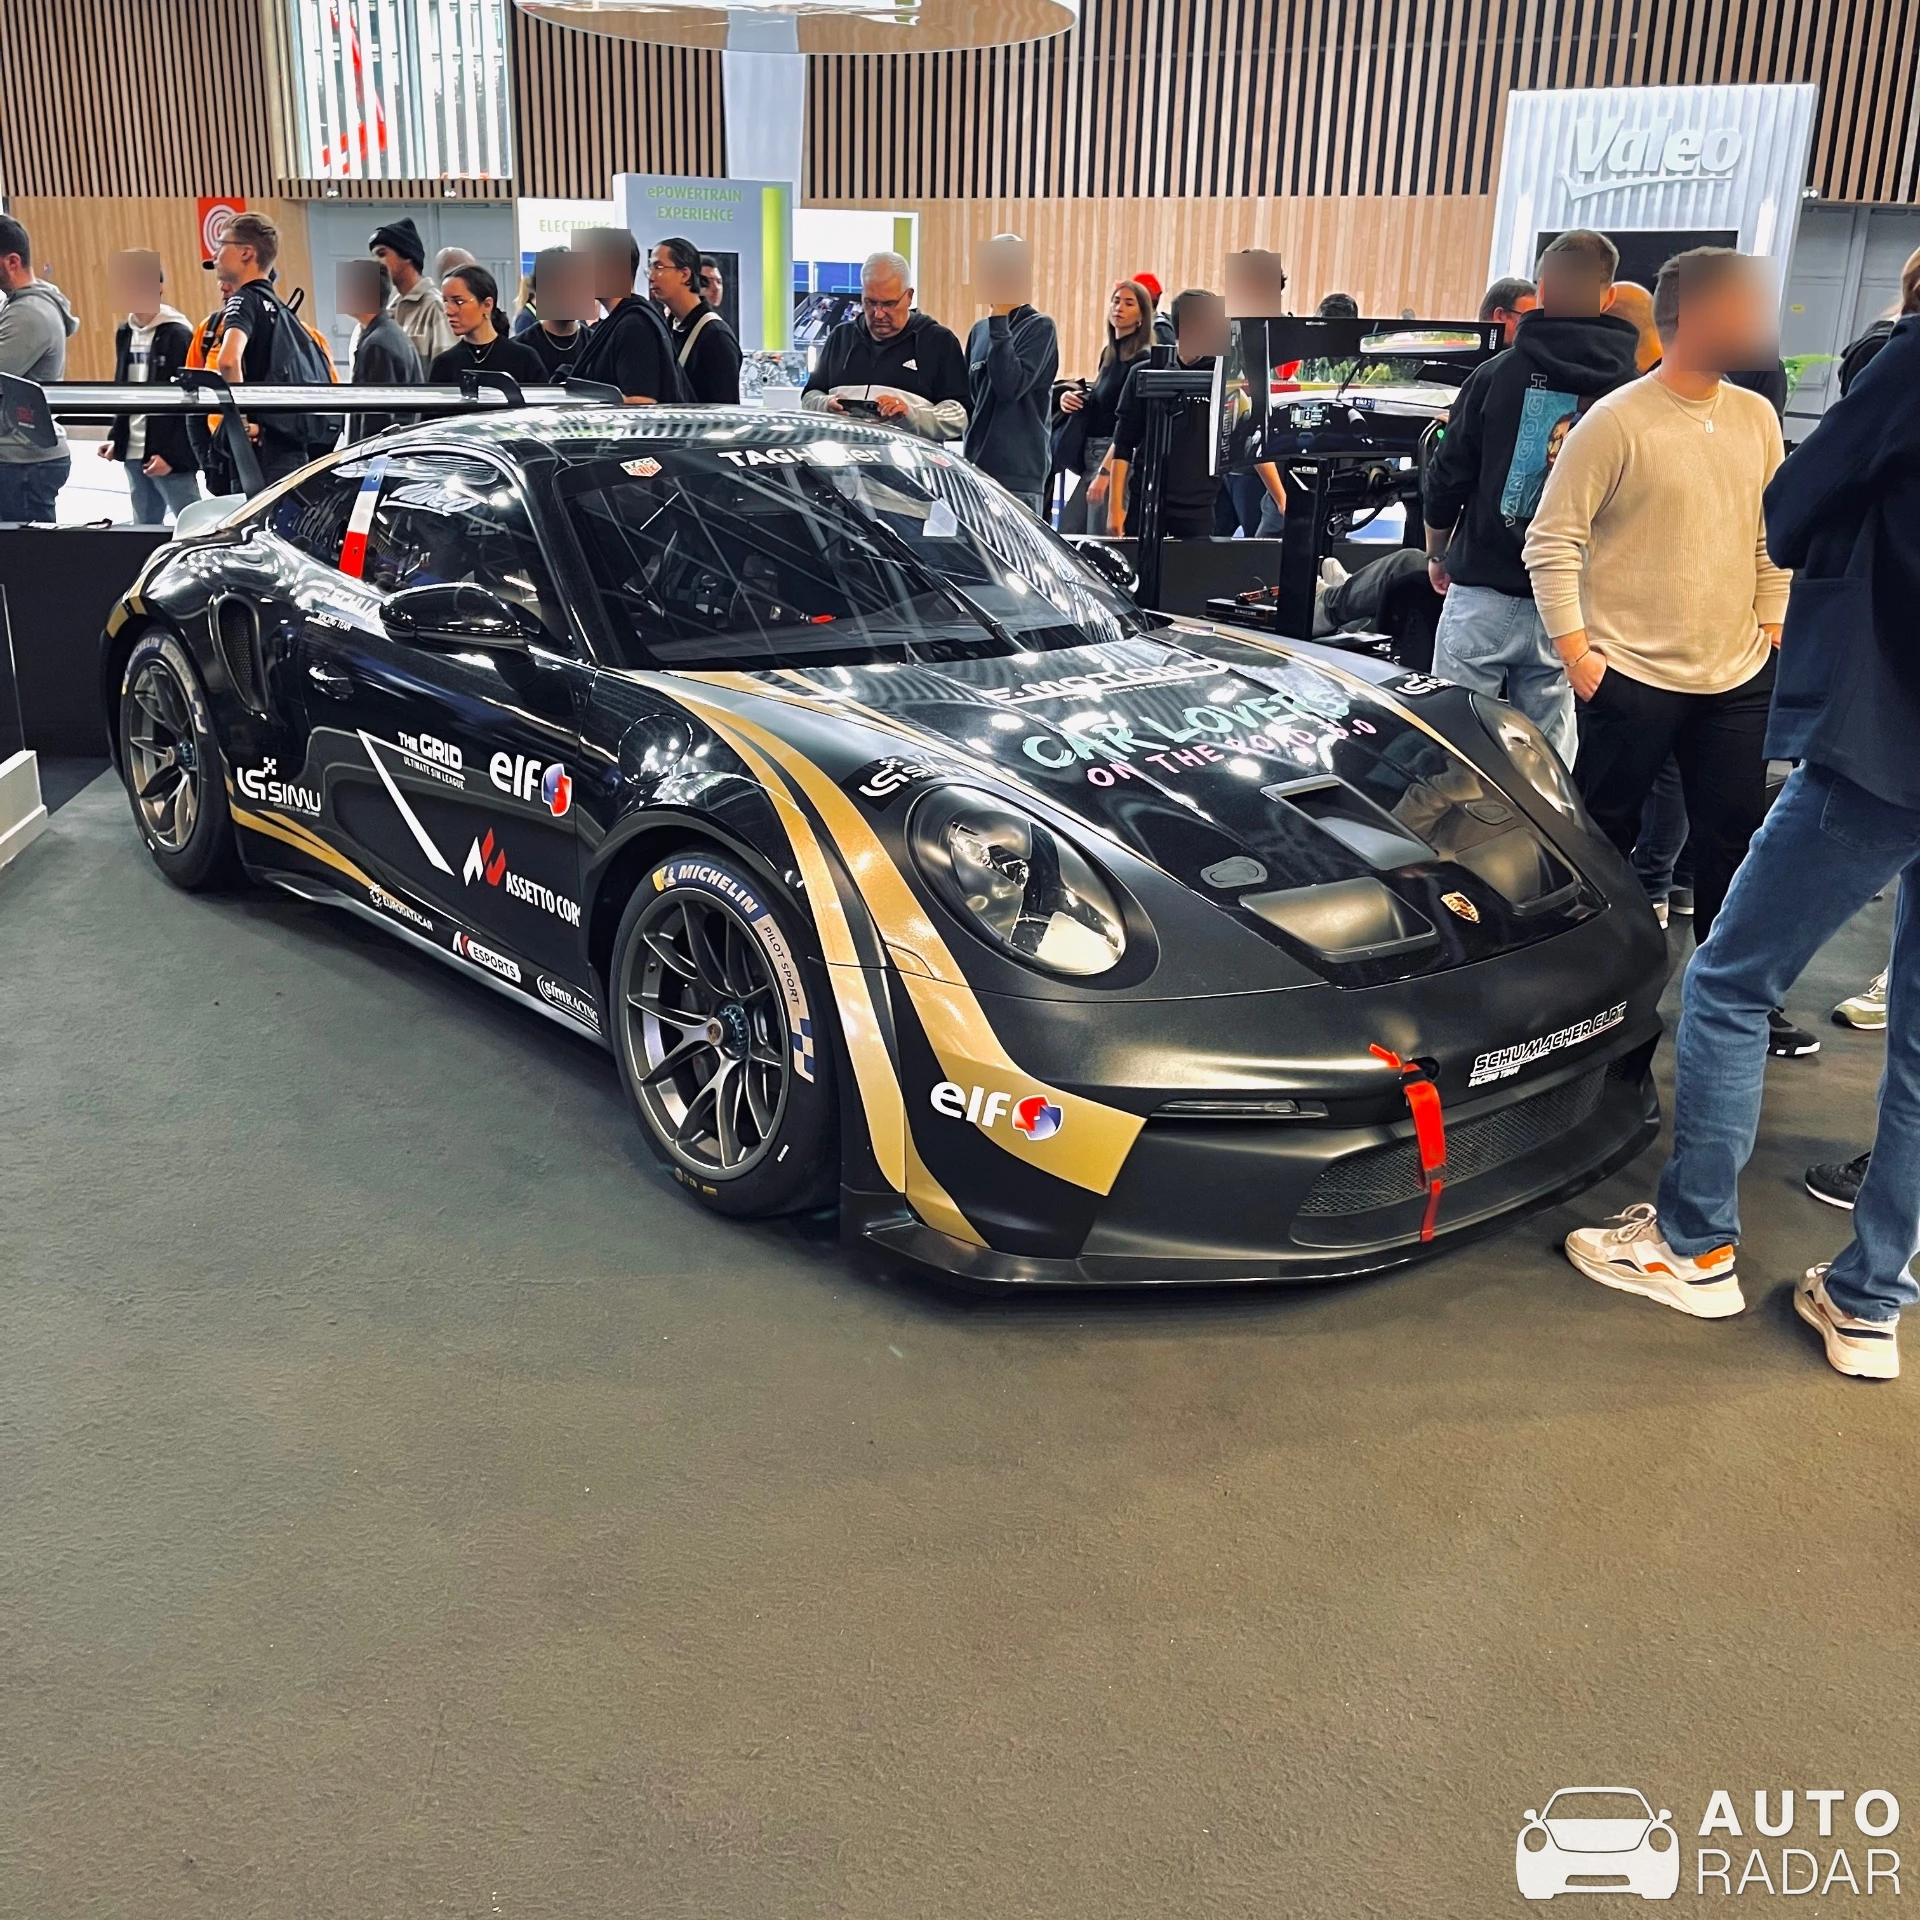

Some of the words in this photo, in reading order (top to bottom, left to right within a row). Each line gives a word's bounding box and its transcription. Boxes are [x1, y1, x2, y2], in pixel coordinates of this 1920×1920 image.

[1576, 117, 1742, 174] Valeo
[647, 185, 742, 202] ePOWERTRAIN
[657, 206, 734, 222] EXPERIENCE
[1504, 471, 1526, 528] VAN
[1516, 373, 1548, 460] GOGH
[397, 731, 419, 752] THE
[420, 733, 463, 771] GRID
[1022, 722, 1169, 769] CAR
[1144, 744, 1225, 774] THE
[267, 781, 321, 812] SIMU
[442, 772, 465, 790] LEAGUE
[490, 751, 542, 802] elf
[505, 870, 555, 914] ASSETTO
[556, 895, 581, 928] COR
[678, 864, 759, 914] MICHELIN
[472, 946, 517, 978] ESPORTS
[763, 926, 785, 958] PILOT
[781, 962, 800, 1006] SPORT
[1472, 1019, 1593, 1074] SCHUMACHER
[930, 1081, 1012, 1128] elf
